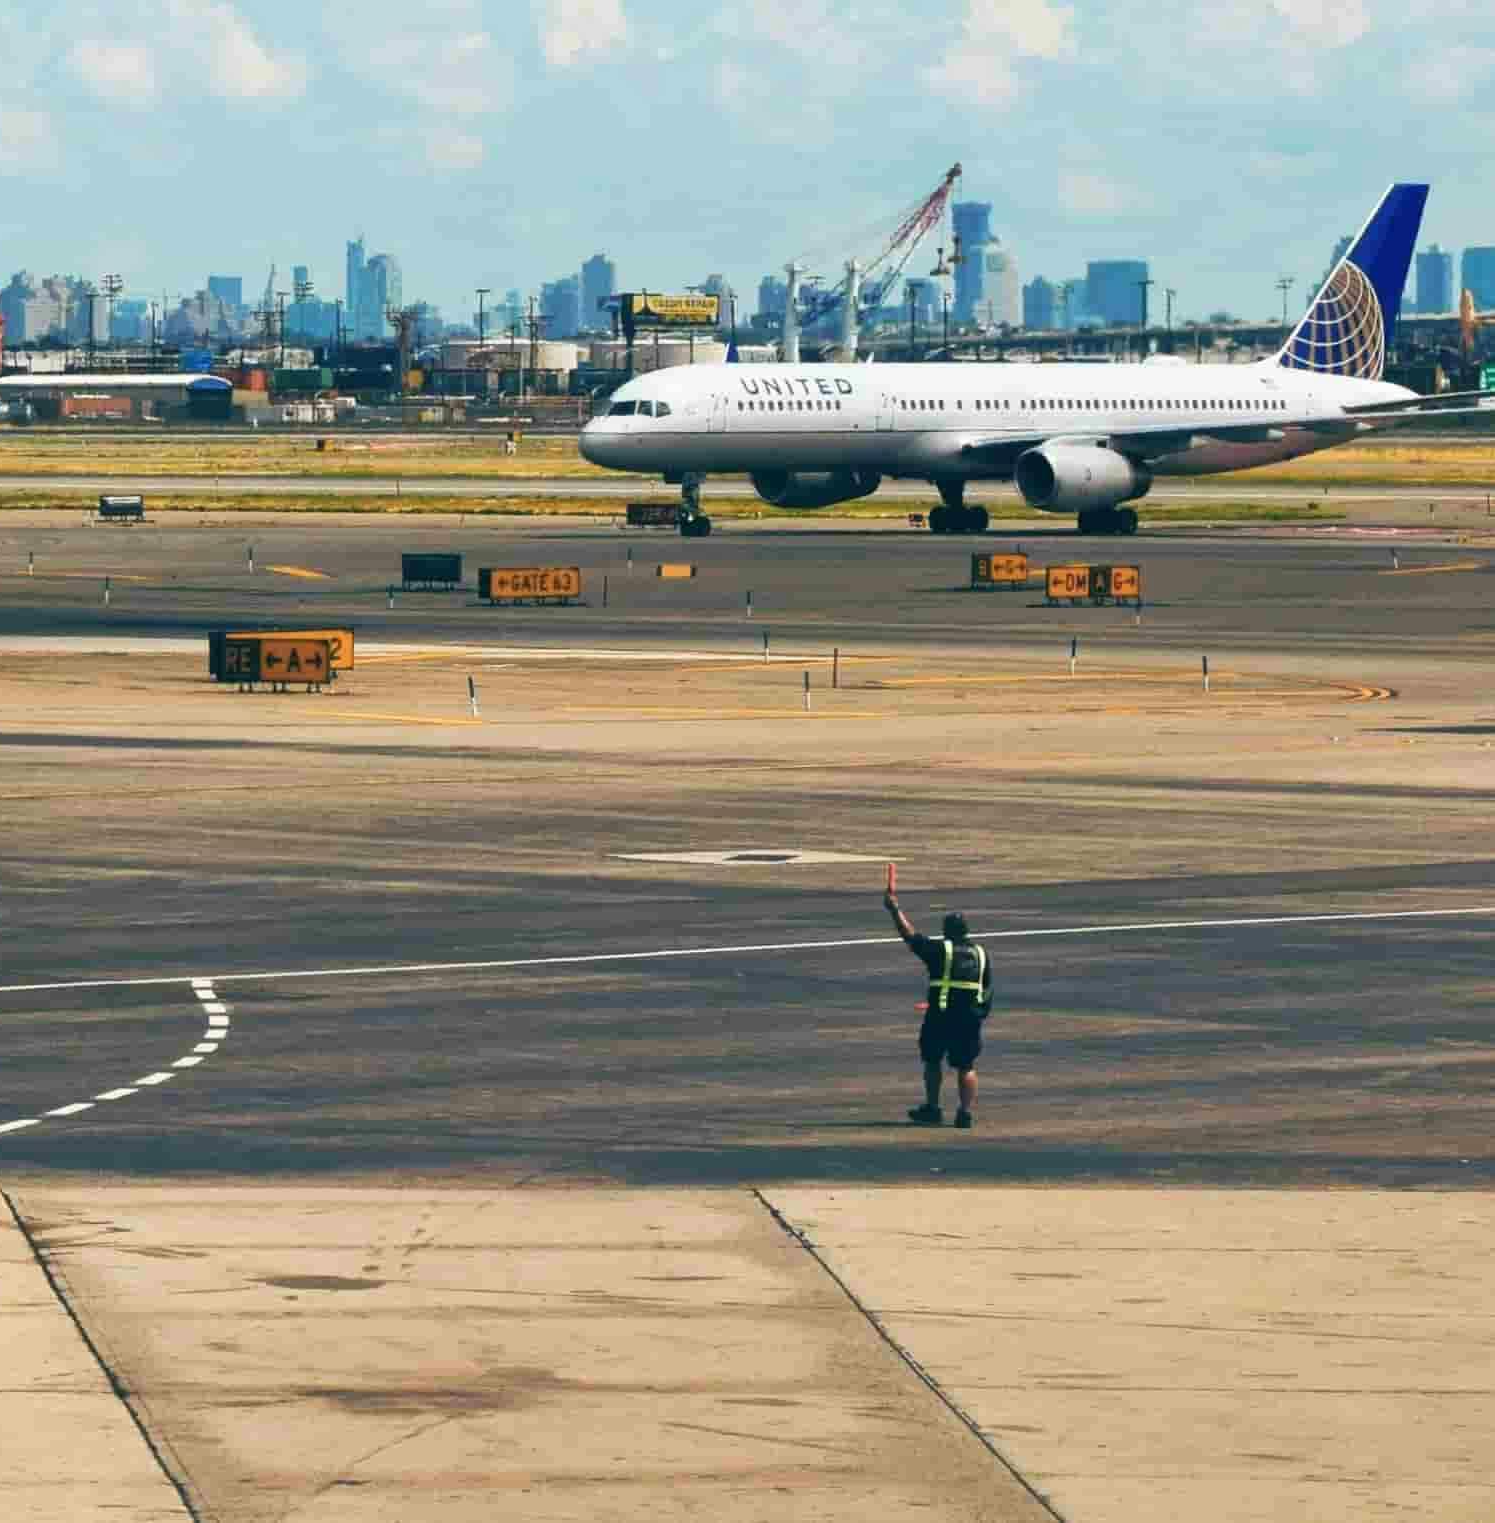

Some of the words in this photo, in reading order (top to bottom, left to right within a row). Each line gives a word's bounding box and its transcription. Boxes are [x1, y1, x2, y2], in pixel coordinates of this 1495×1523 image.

[739, 377, 853, 395] UNITED
[511, 572, 550, 592] GATE
[1065, 573, 1087, 593] DM
[1113, 572, 1124, 591] G
[287, 647, 302, 673] A
